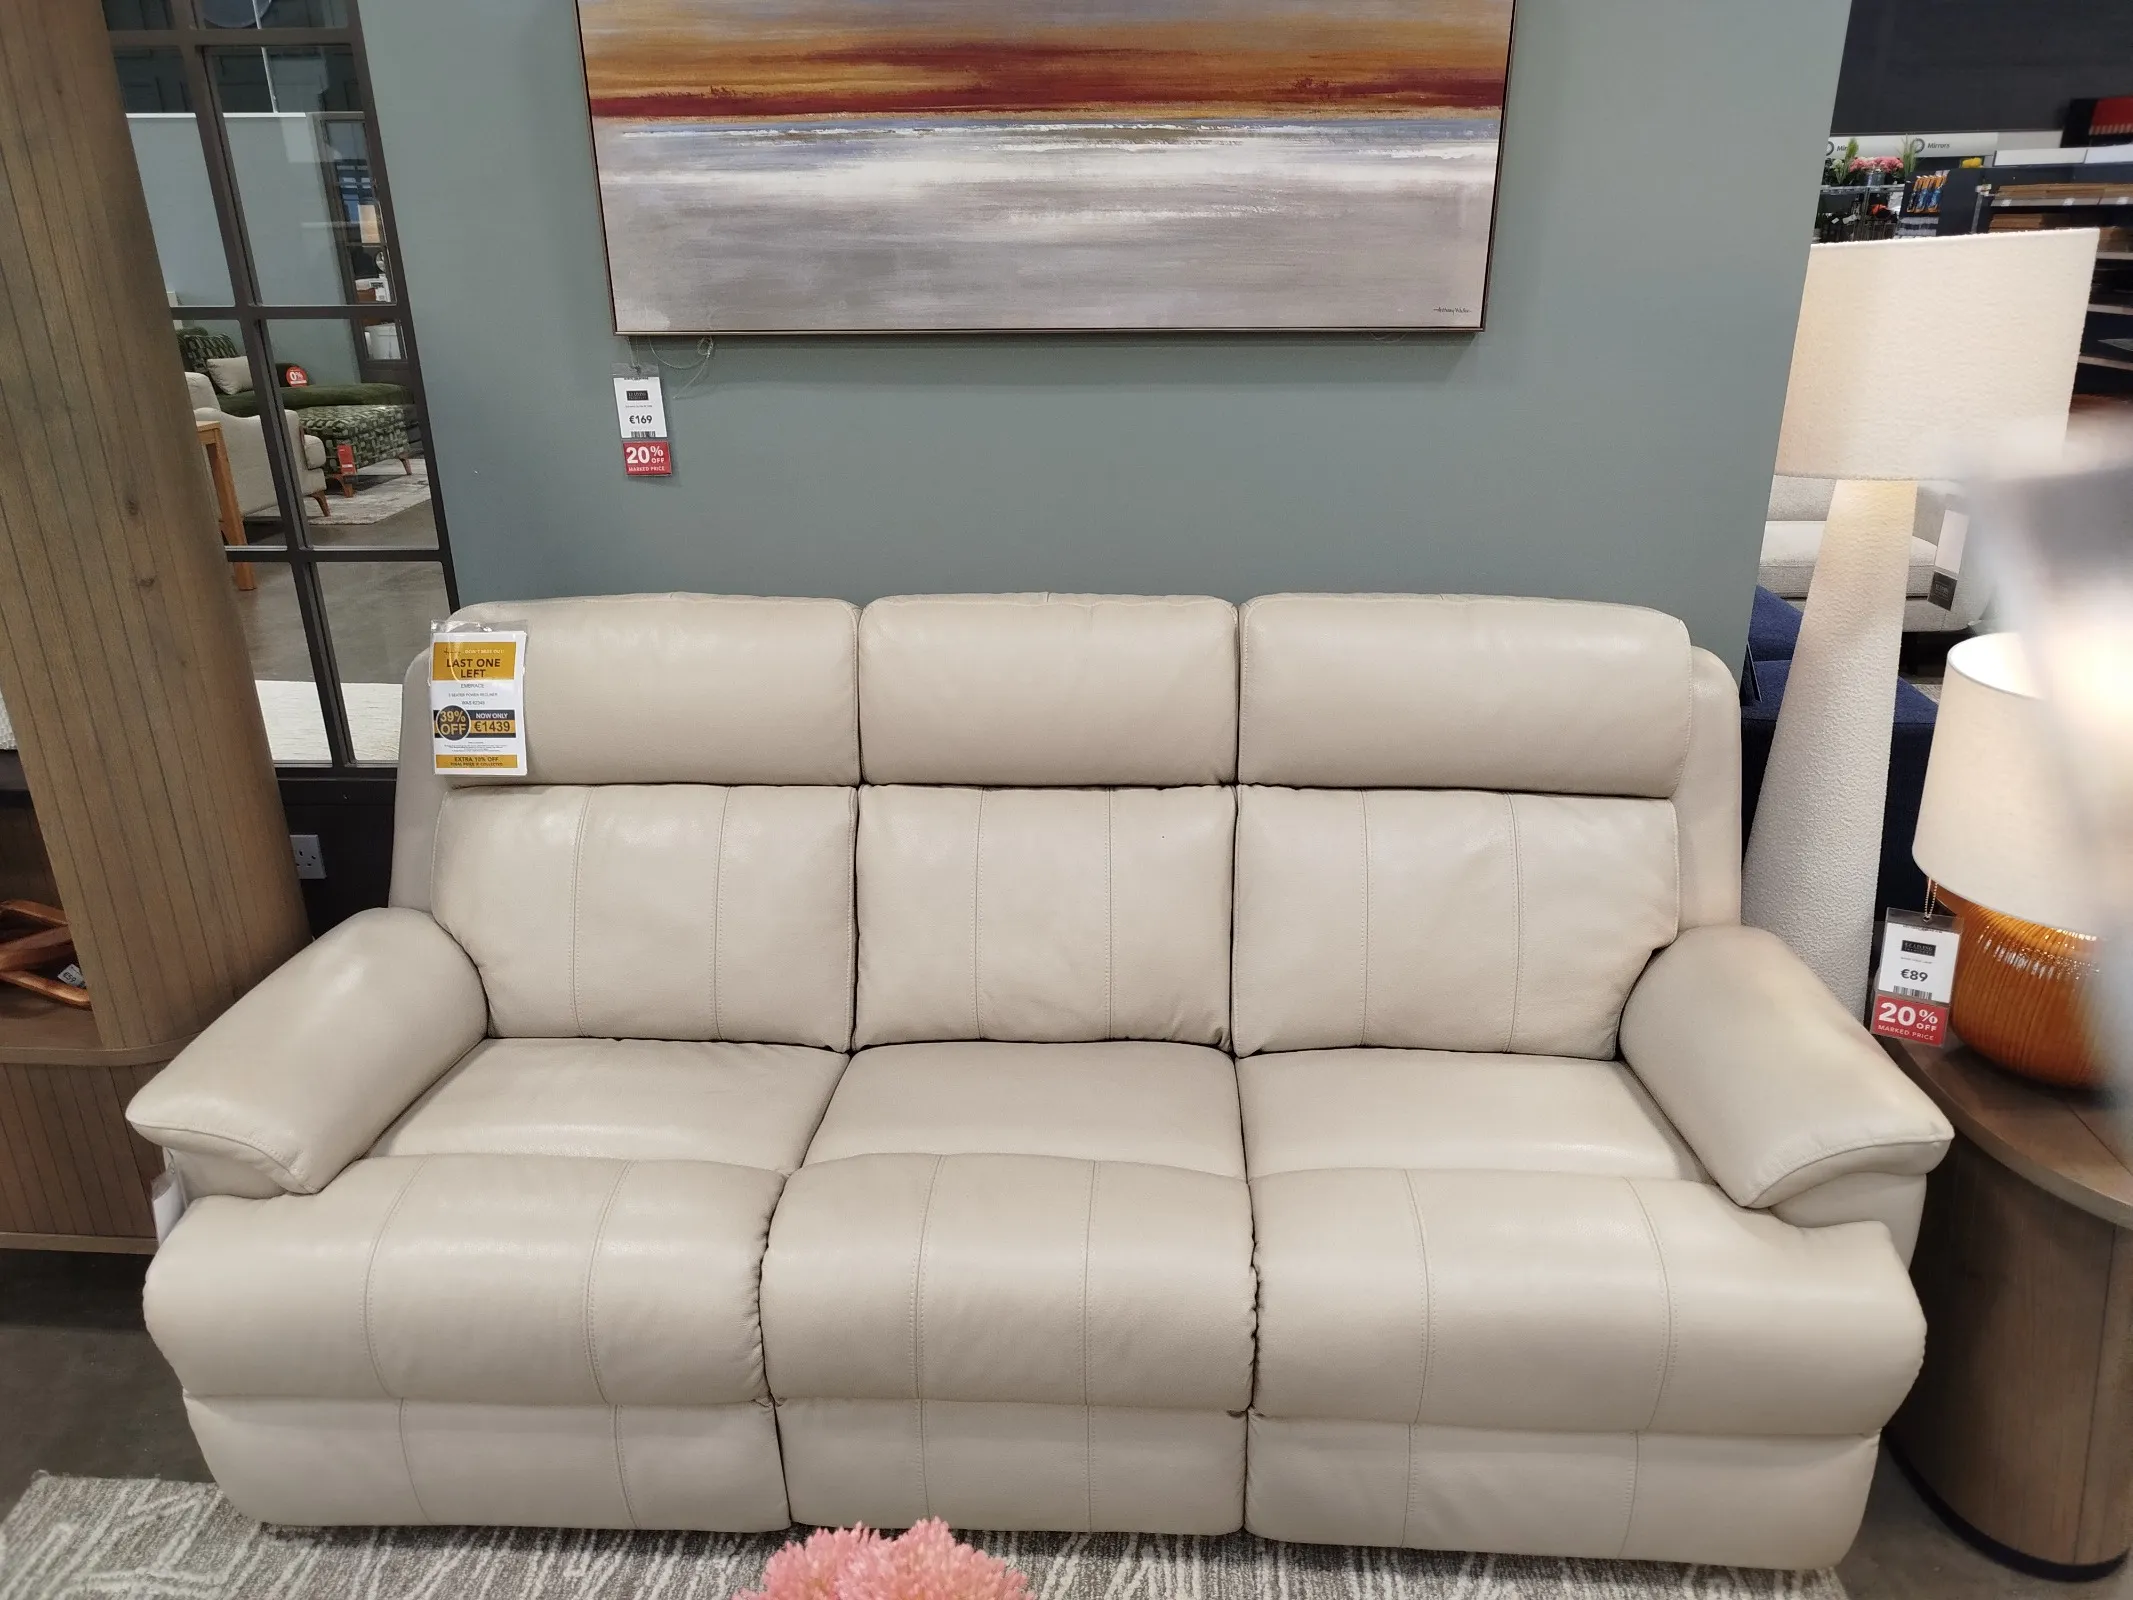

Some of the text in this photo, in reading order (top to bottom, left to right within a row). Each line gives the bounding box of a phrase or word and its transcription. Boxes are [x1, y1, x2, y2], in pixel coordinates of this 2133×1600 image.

[629, 415, 652, 424] €169
[626, 446, 664, 464] 20%
[446, 658, 501, 668] LAST ONE
[460, 669, 486, 678] LEFT
[440, 710, 466, 723] 39%
[440, 723, 467, 736] OFF
[474, 721, 511, 732] €1439
[1901, 968, 1928, 982] €89
[1878, 1002, 1938, 1026] 20%
[1878, 1024, 1934, 1040] MARKED PRICE
[1916, 1022, 1937, 1032] OFF
